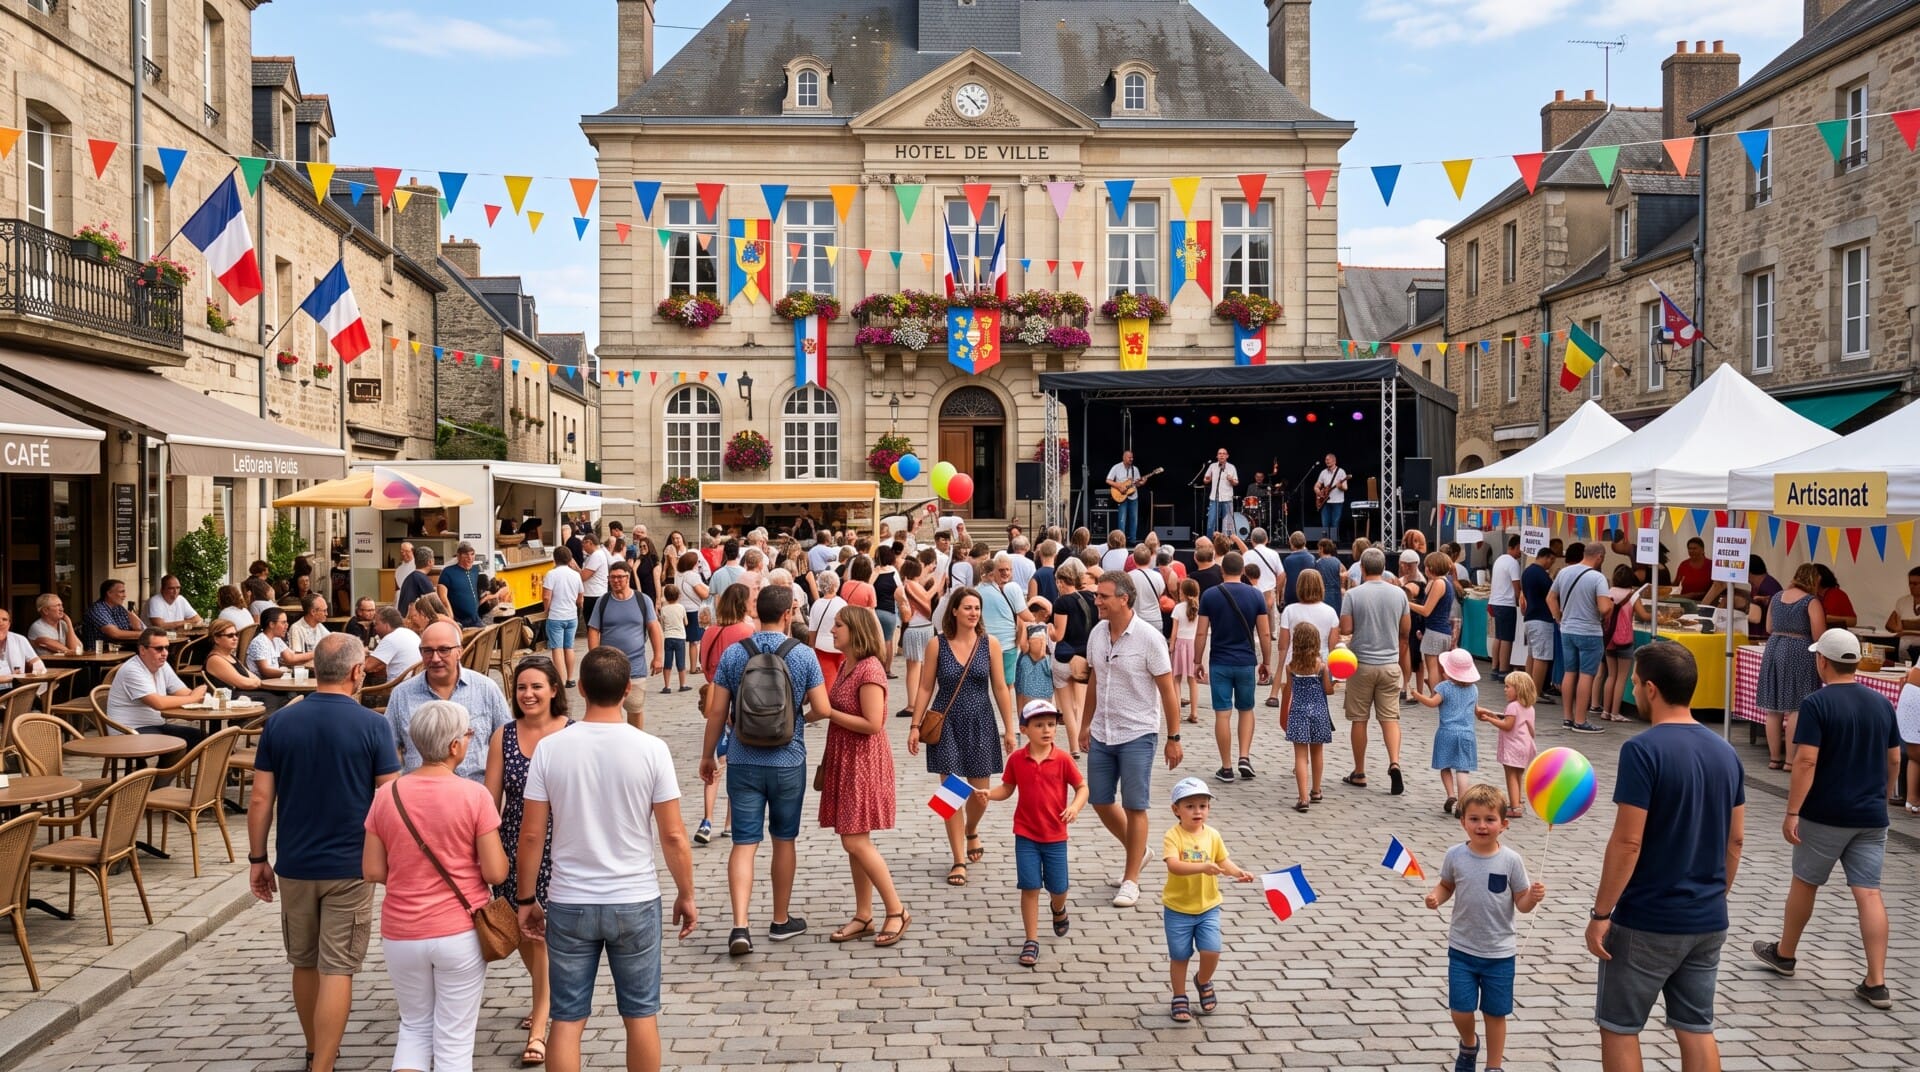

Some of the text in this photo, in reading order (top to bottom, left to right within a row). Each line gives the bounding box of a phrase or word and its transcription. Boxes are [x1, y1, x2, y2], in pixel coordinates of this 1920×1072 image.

[895, 144, 1049, 160] HOTEL DE VILLE
[4, 438, 51, 467] CAFÉ
[1449, 483, 1514, 500] Ateliers Enfants
[1574, 481, 1617, 499] Buvette
[1787, 481, 1869, 507] Artisanat
